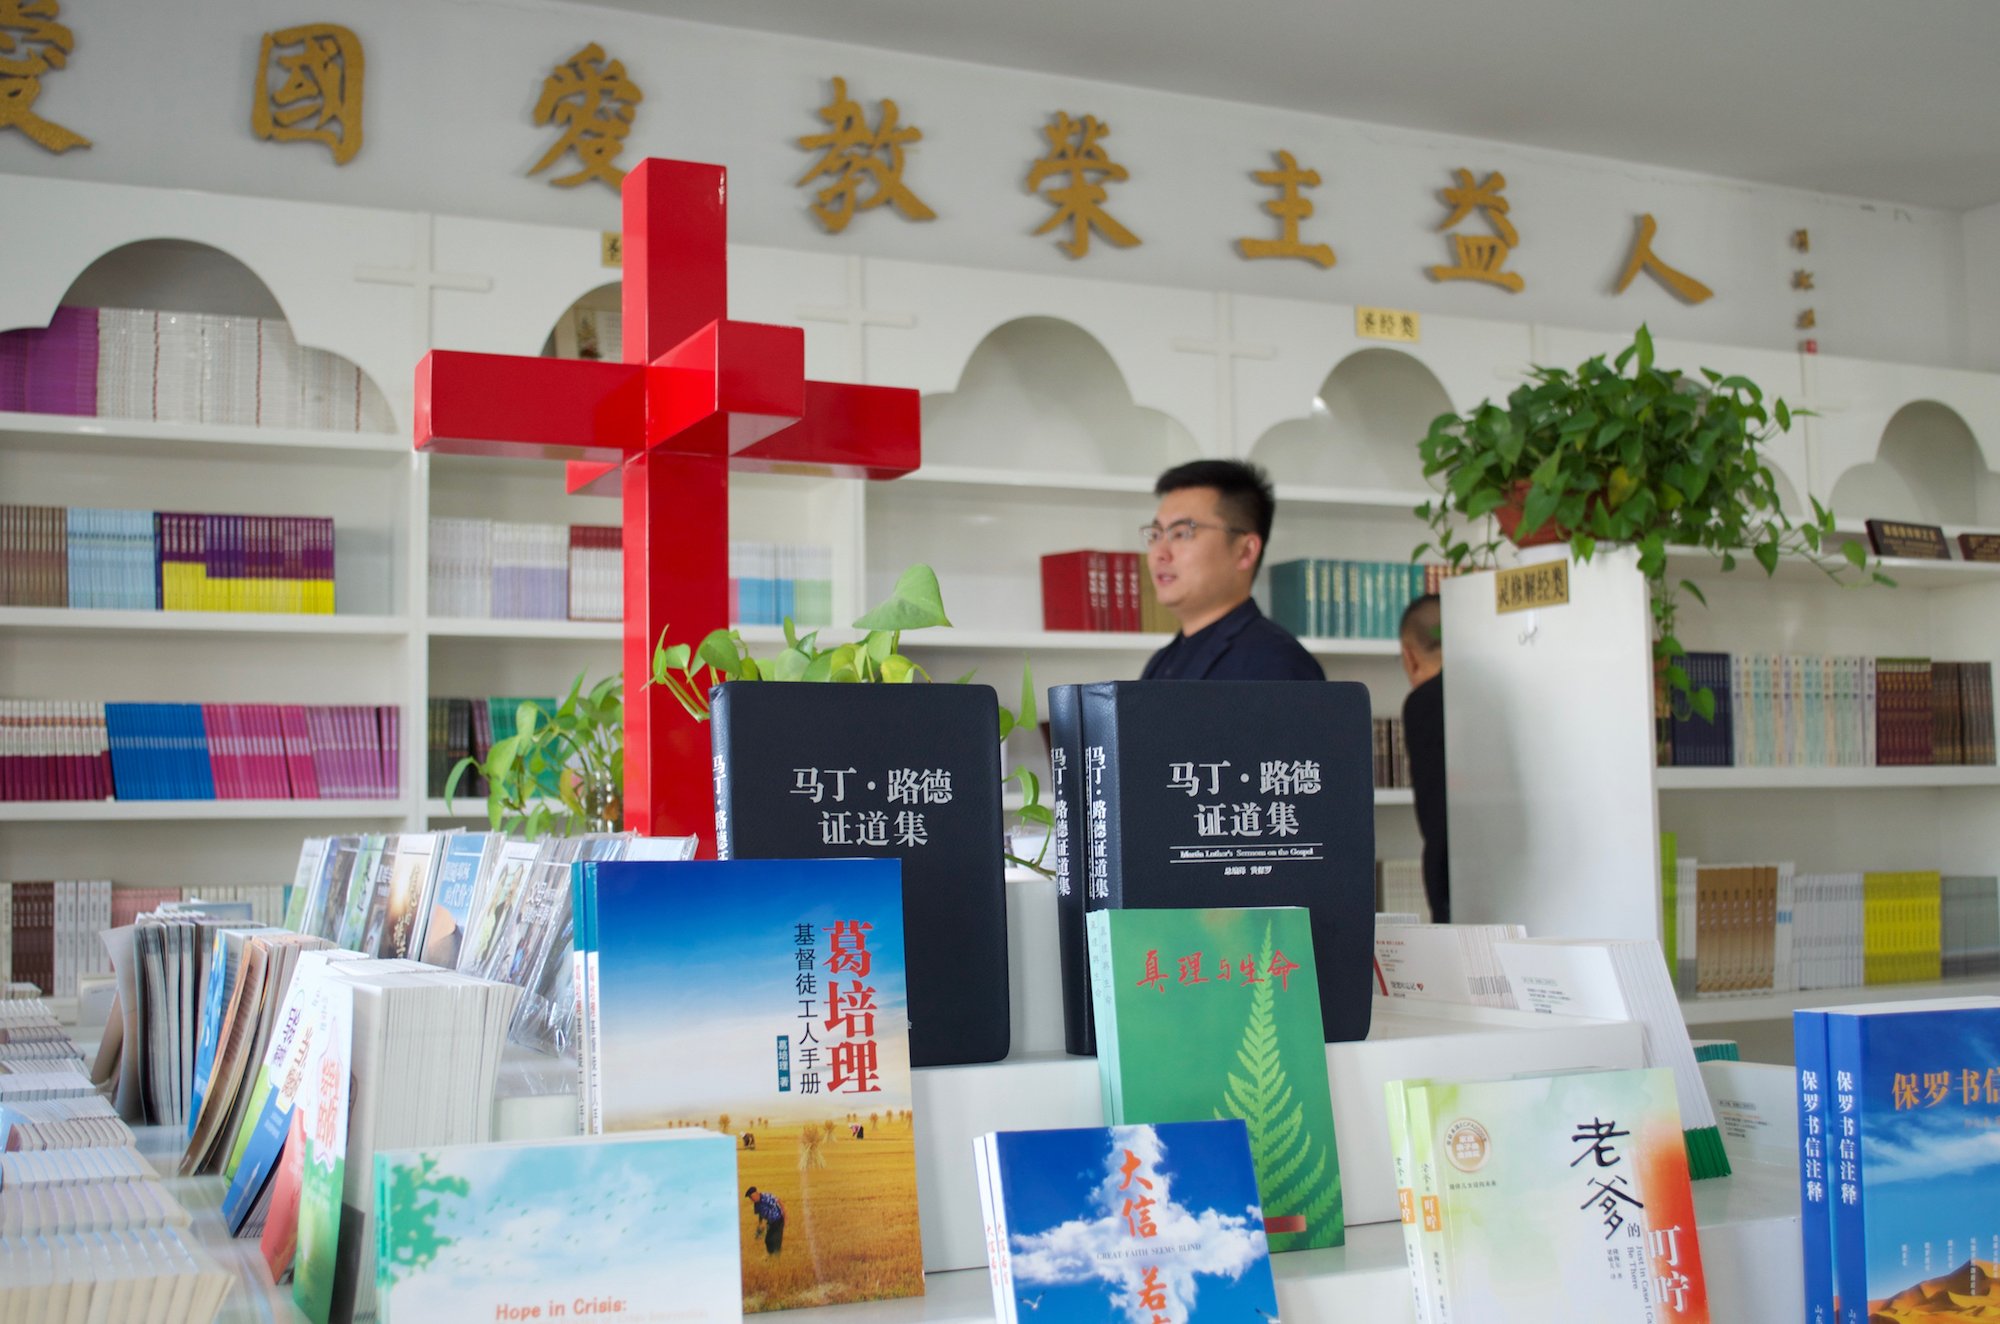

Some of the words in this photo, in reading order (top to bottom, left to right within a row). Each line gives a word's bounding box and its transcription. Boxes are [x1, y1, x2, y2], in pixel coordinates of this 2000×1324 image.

[789, 767, 953, 804] 马丁·路德
[1166, 759, 1322, 797] 马丁·路德
[817, 810, 929, 848] 证道集
[1052, 747, 1071, 897] 马丁·路德证道集
[1091, 745, 1109, 899] 马丁·路德证道集
[1193, 801, 1300, 838] 证道集
[1180, 850, 1204, 858] Martin
[1236, 849, 1266, 857] Sermons
[1278, 848, 1289, 856] the
[1290, 847, 1314, 858] Gospel
[1136, 949, 1300, 993] 真理与生命
[794, 923, 821, 1094] 基督徒工人手册
[821, 920, 882, 1094] 葛培理
[777, 1039, 789, 1071] 葛培理
[779, 1076, 789, 1088] 著
[1892, 1067, 2000, 1111] 保罗书信
[1802, 1070, 1823, 1202] 保罗书信注释
[1836, 1070, 1857, 1205] 保罗书信注释
[1627, 1222, 1641, 1238] 的
[1096, 1250, 1121, 1260] GREAT
[1125, 1247, 1149, 1258] FAITH
[1151, 1245, 1175, 1255] SEEMS
[1178, 1243, 1201, 1252] BLIND
[1627, 1246, 1634, 1259] Be
[1636, 1245, 1644, 1265] Just
[1647, 1224, 1690, 1313] 叮咛
[1629, 1261, 1638, 1289] There
[1639, 1267, 1646, 1278] in
[495, 1304, 541, 1321] Hope
[549, 1300, 565, 1317] in
[573, 1296, 627, 1315] Crisis:
[1641, 1280, 1649, 1303] Case
